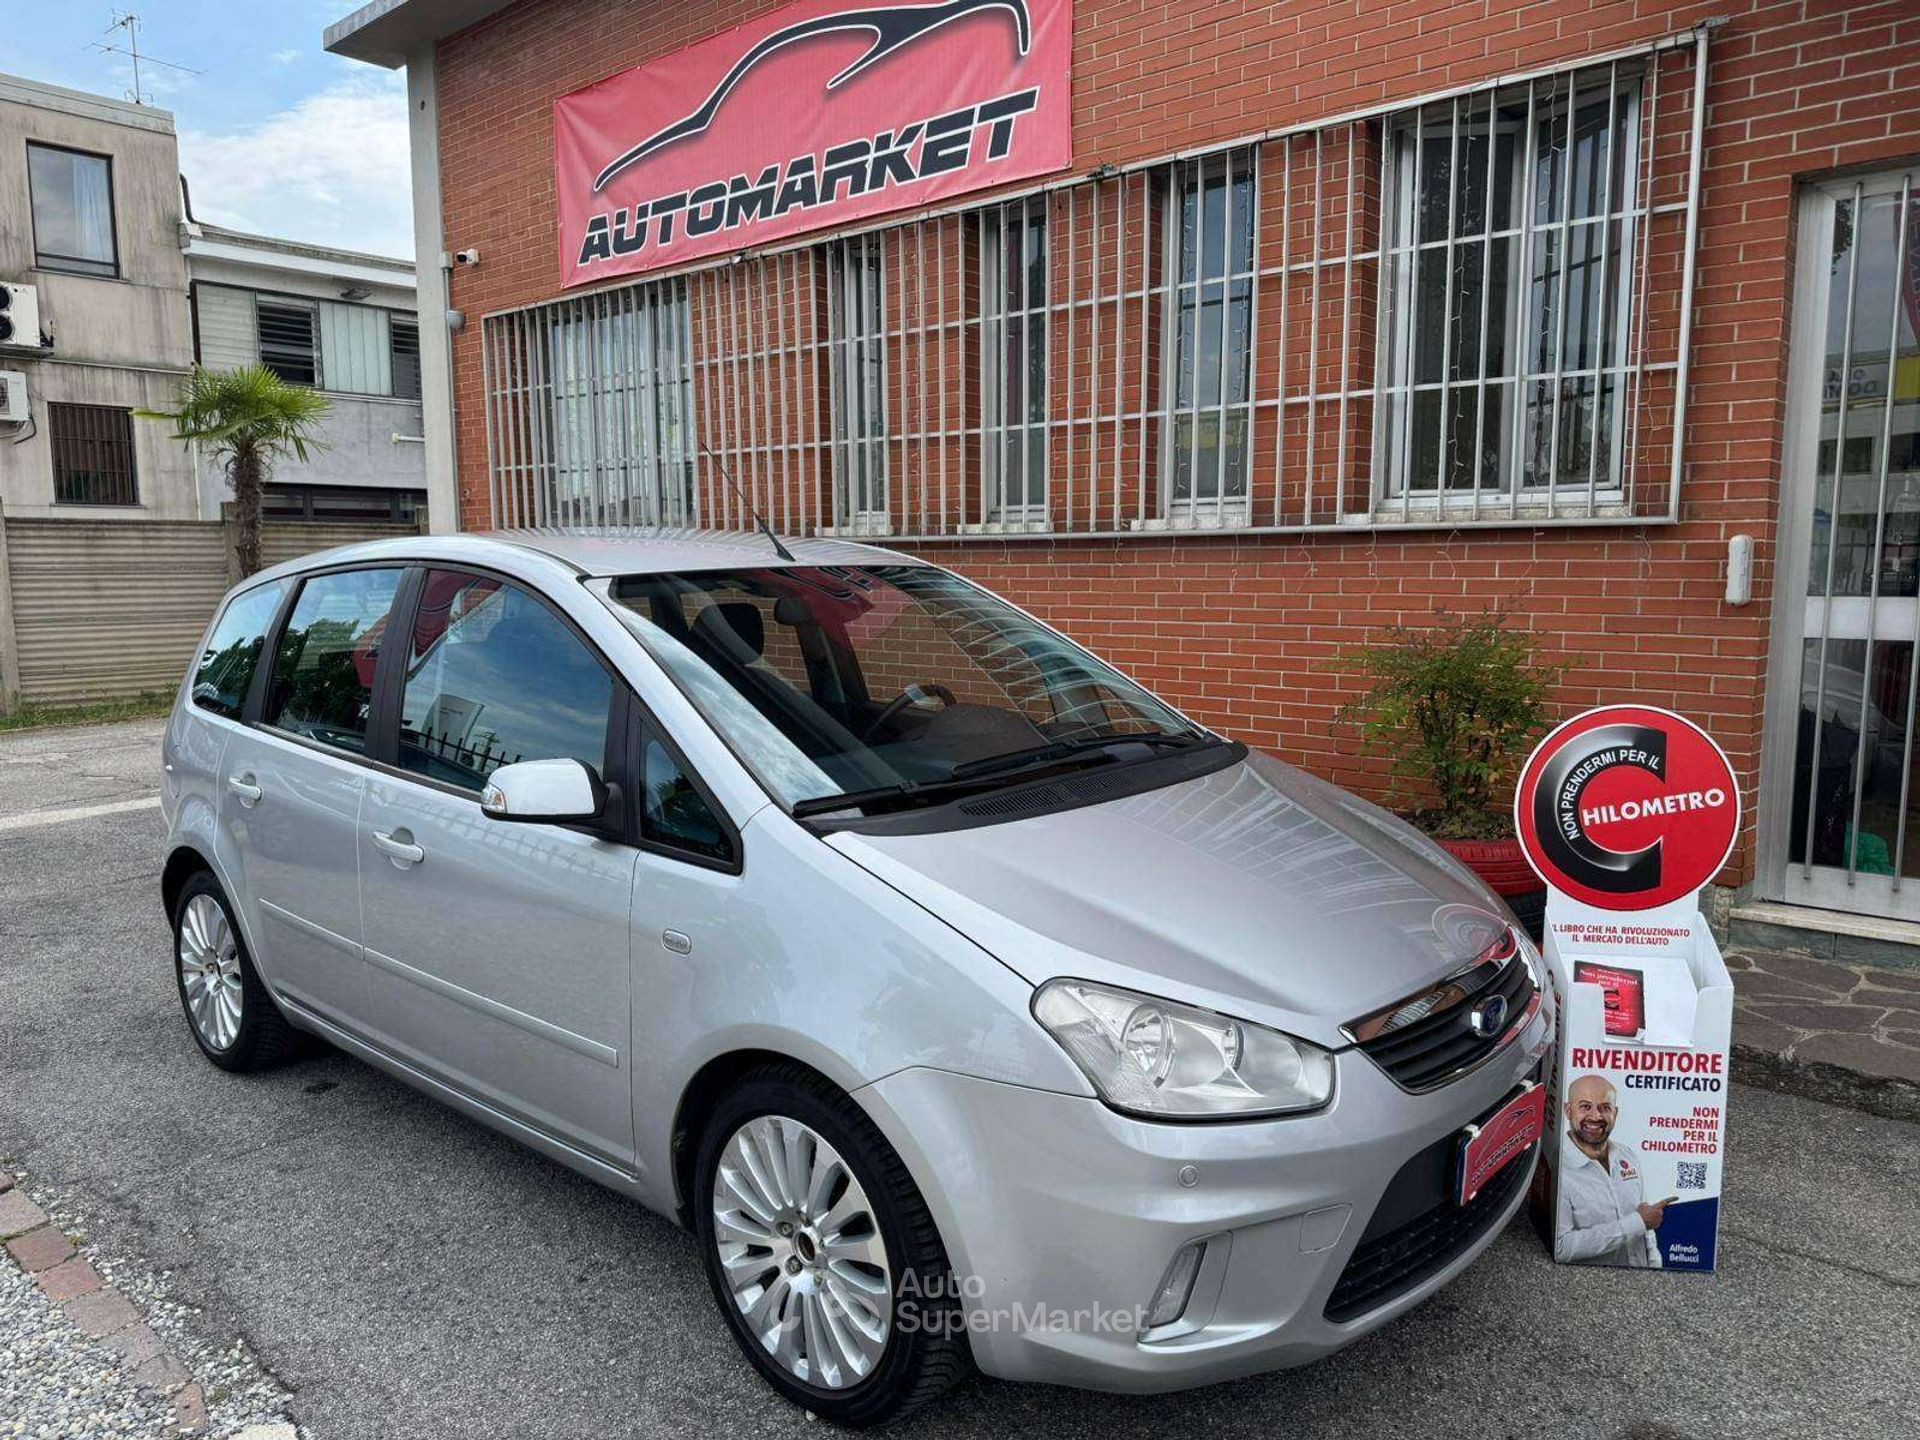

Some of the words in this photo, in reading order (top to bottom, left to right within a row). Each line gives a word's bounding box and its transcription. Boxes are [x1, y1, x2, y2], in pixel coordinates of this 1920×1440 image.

[577, 85, 1040, 266] AUTOMARKET
[1620, 750, 1647, 764] PER
[1648, 755, 1660, 770] IL
[1561, 751, 1616, 809] PRENDERMI
[1561, 813, 1580, 840] NON
[1560, 924, 1584, 933] LIBRO
[1586, 925, 1603, 934] CHE
[1605, 926, 1618, 934] HA
[1621, 927, 1690, 937] RIVOLUZIONATO
[1572, 934, 1579, 942] IL
[1583, 935, 1623, 943] MERCATO
[1625, 937, 1669, 946] DELL'AUTO
[1572, 1047, 1722, 1074] RIVENDITORE
[1625, 1074, 1721, 1092] CERTIFICATO
[1693, 1107, 1719, 1118] NON
[1649, 1117, 1718, 1130] PRENDERMI
[1683, 1131, 1705, 1141] PER
[1708, 1132, 1718, 1142] IL
[1641, 1140, 1717, 1154] CHILOMETRO
[1669, 1243, 1698, 1253] Alfredo
[1669, 1253, 1699, 1263] Bellucci
